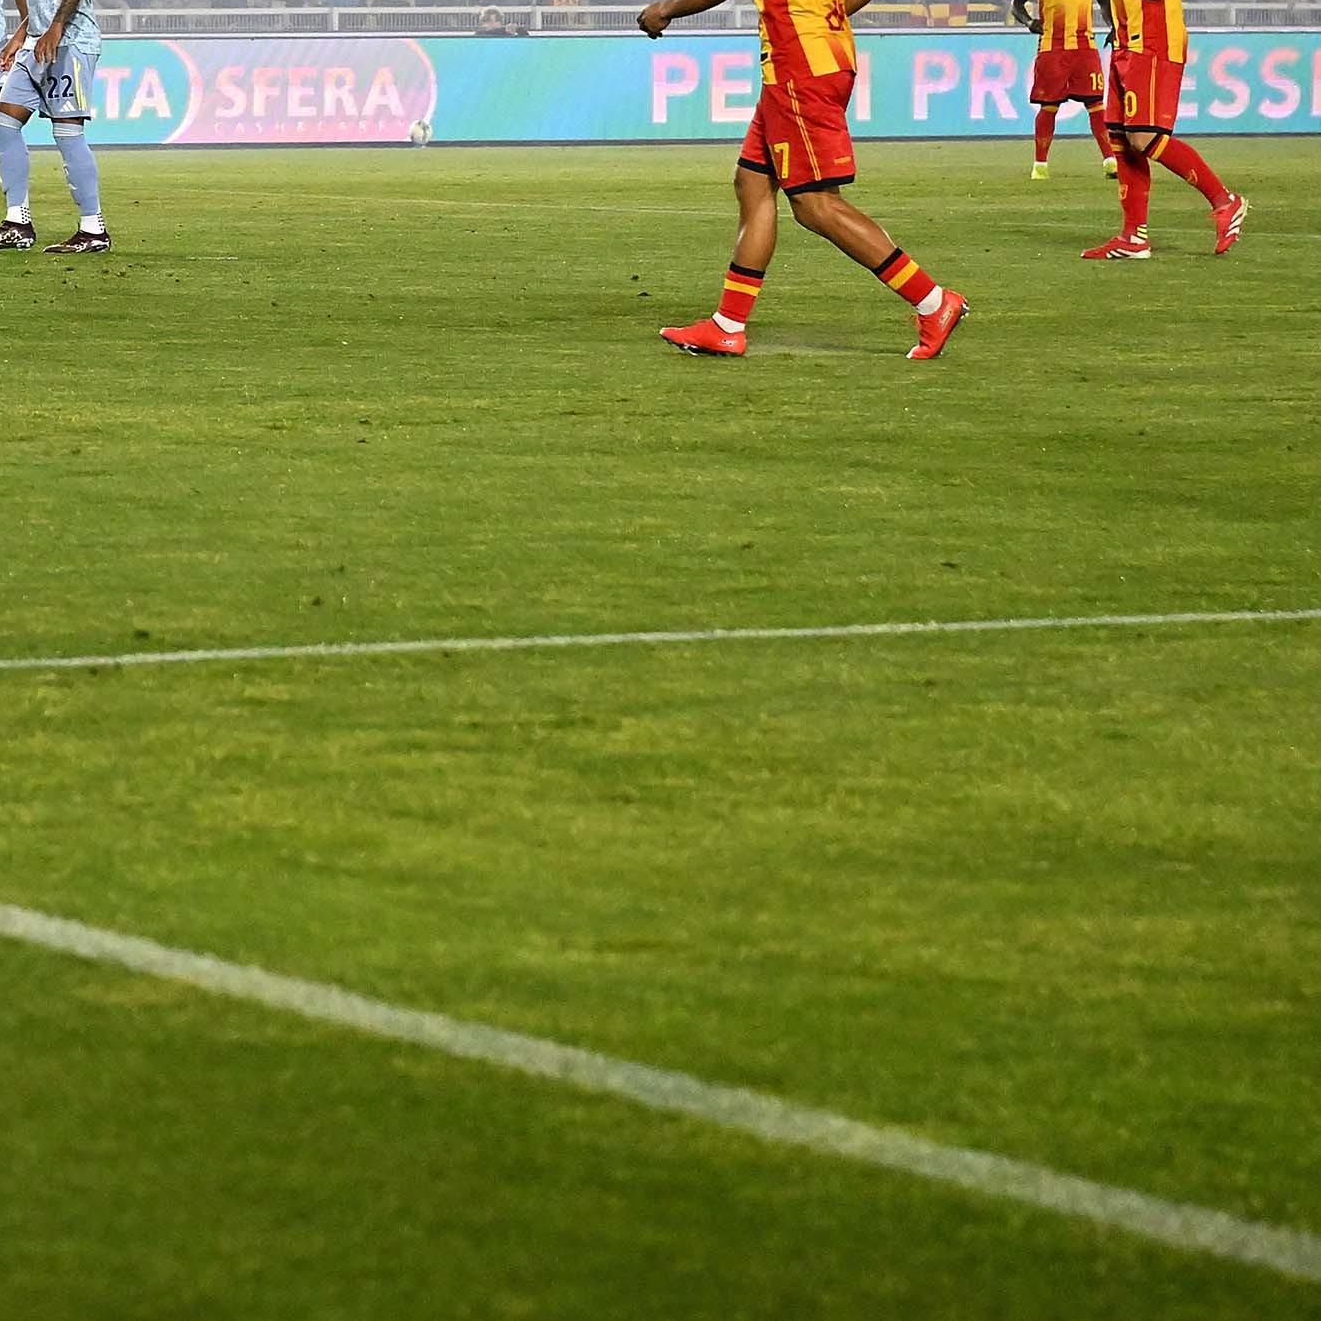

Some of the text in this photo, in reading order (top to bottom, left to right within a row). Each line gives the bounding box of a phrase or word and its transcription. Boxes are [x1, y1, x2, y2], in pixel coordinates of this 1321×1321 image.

[47, 74, 75, 100] 22
[214, 65, 406, 121] SFERA
[1090, 72, 1105, 91] 19
[1124, 90, 1137, 118] 0
[773, 141, 790, 179] 7
